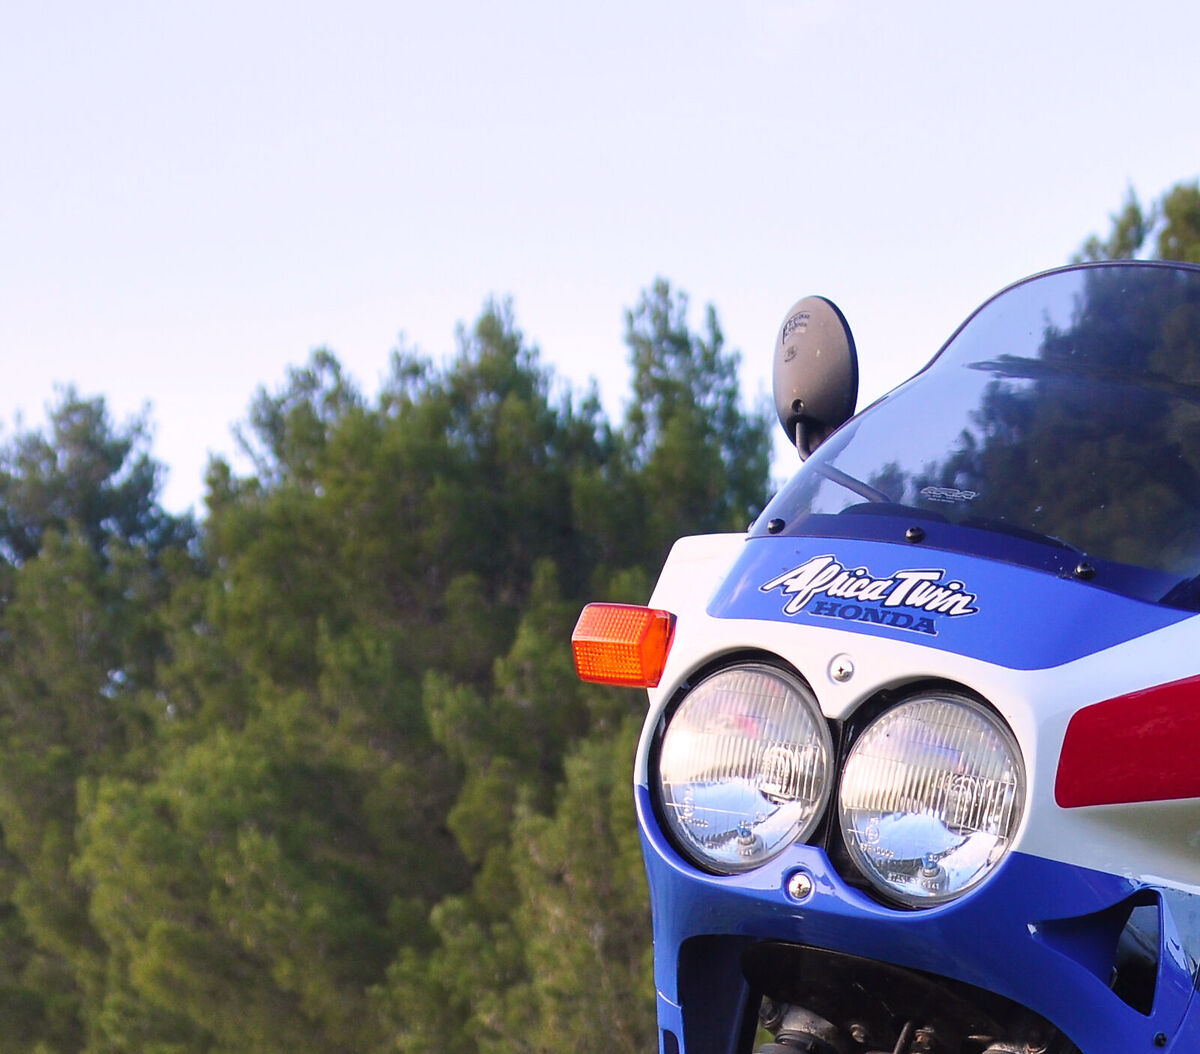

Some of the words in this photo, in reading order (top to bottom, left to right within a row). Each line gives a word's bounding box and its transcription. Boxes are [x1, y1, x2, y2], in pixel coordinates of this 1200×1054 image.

[760, 555, 894, 615] Africa
[884, 569, 980, 616] Twin
[810, 601, 938, 635] HONDA
